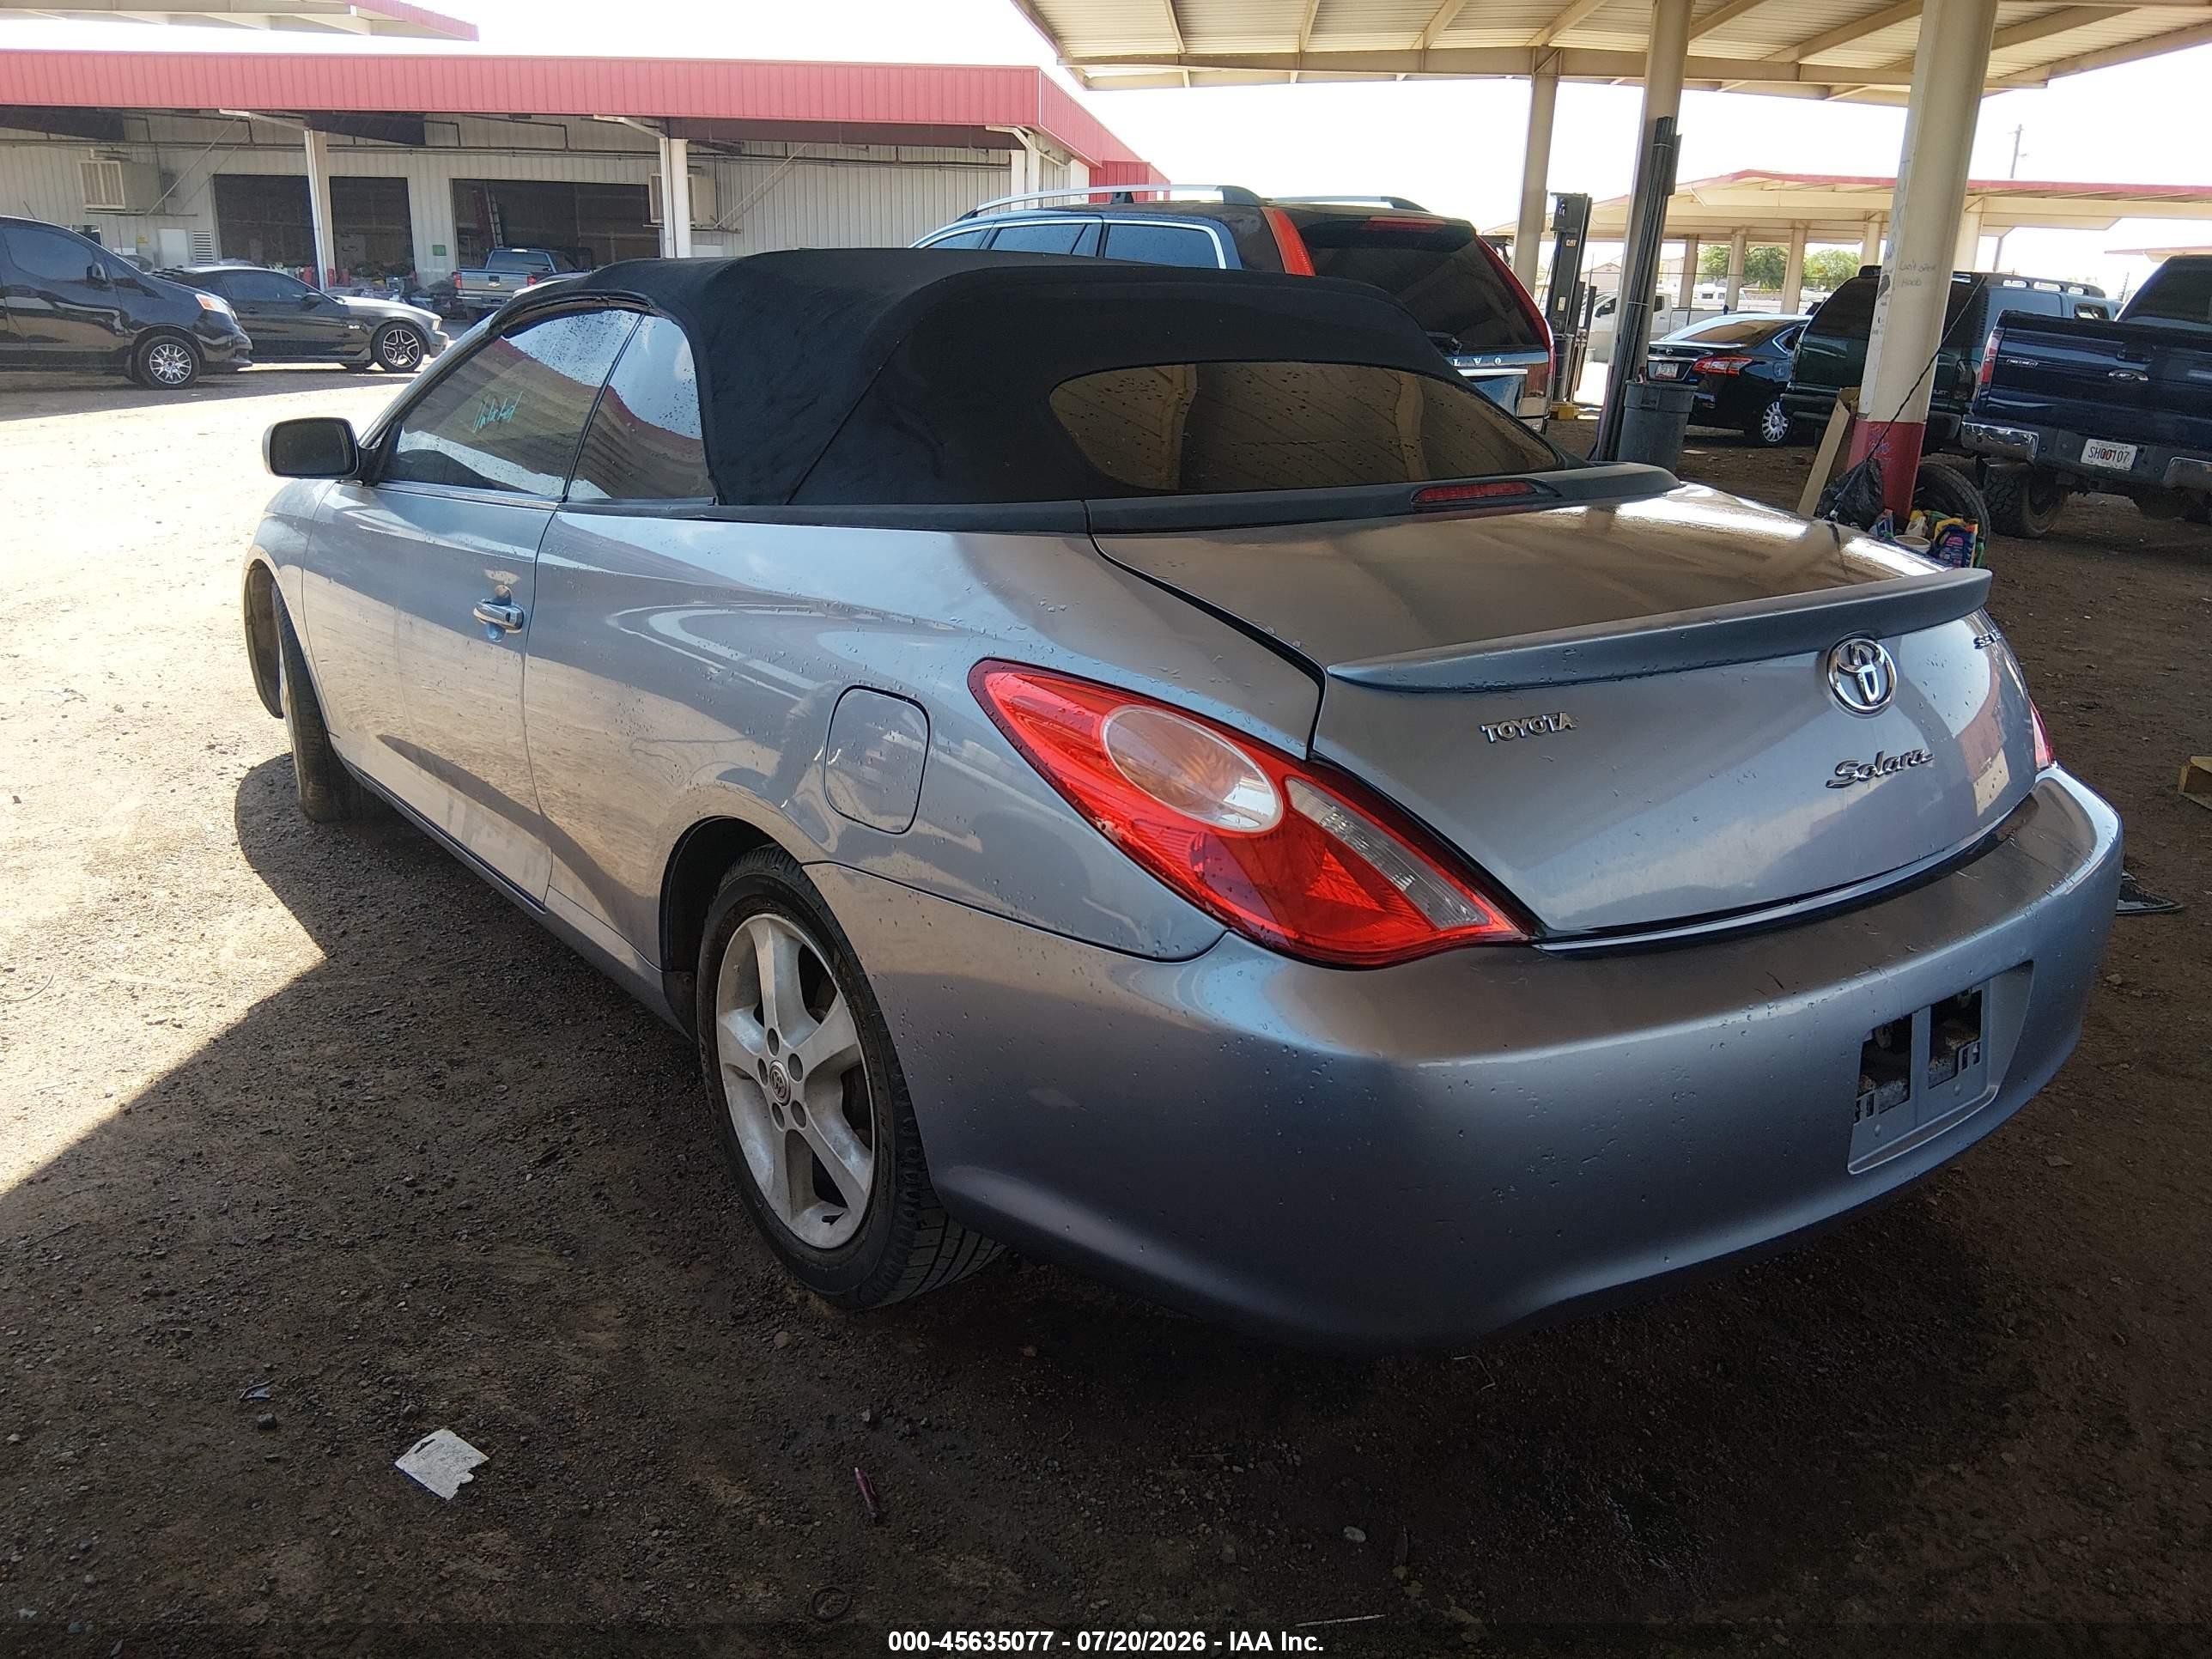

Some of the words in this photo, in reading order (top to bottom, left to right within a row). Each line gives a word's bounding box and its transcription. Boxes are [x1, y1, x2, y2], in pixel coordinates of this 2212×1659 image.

[1565, 239, 1577, 247] CAT
[1452, 356, 1502, 367] LVO
[1480, 712, 1578, 744] TOYOTA
[1826, 750, 1935, 788] Solara
